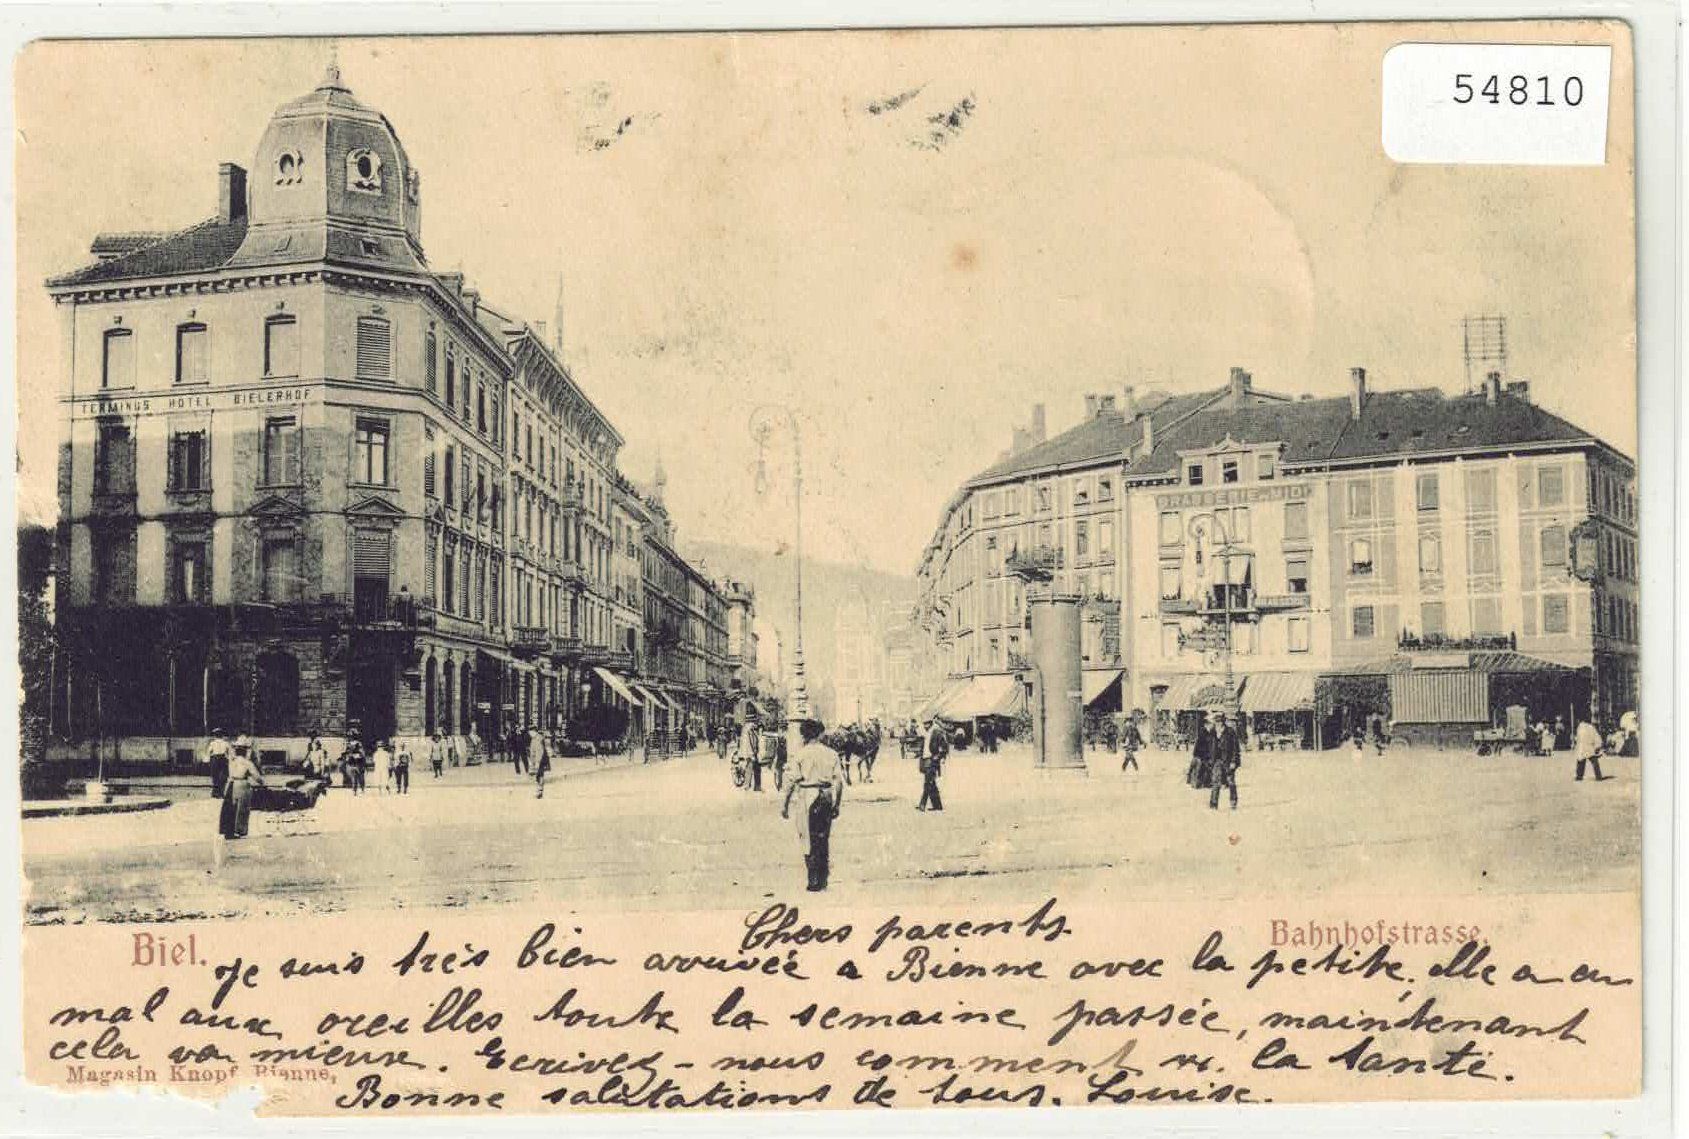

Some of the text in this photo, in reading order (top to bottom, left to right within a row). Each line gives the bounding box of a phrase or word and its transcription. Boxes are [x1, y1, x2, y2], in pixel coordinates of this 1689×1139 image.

[1453, 73, 1584, 106] 54810
[168, 396, 211, 409] HOTEL
[234, 389, 312, 405] BIELERHOF
[741, 903, 849, 951] Chers
[215, 957, 258, 1009] Je
[281, 950, 365, 975] suis
[516, 922, 617, 969] bien
[887, 945, 1047, 983] Bienne
[1069, 956, 1164, 978] avec
[1191, 930, 1235, 972] la
[1512, 964, 1563, 984] a
[50, 986, 169, 1026] mal
[180, 1008, 282, 1040] aux
[317, 987, 504, 1037] oreilles
[534, 988, 679, 1034] toute
[711, 986, 770, 1030] la
[790, 1001, 1026, 1031] semaine
[1259, 991, 1590, 1044] maintenant
[50, 1025, 140, 1060] cela
[855, 1038, 1143, 1077] comment
[1252, 1037, 1312, 1070] la
[335, 1074, 506, 1110] Bonne
[541, 1071, 831, 1110] salutations
[853, 1074, 897, 1108] de
